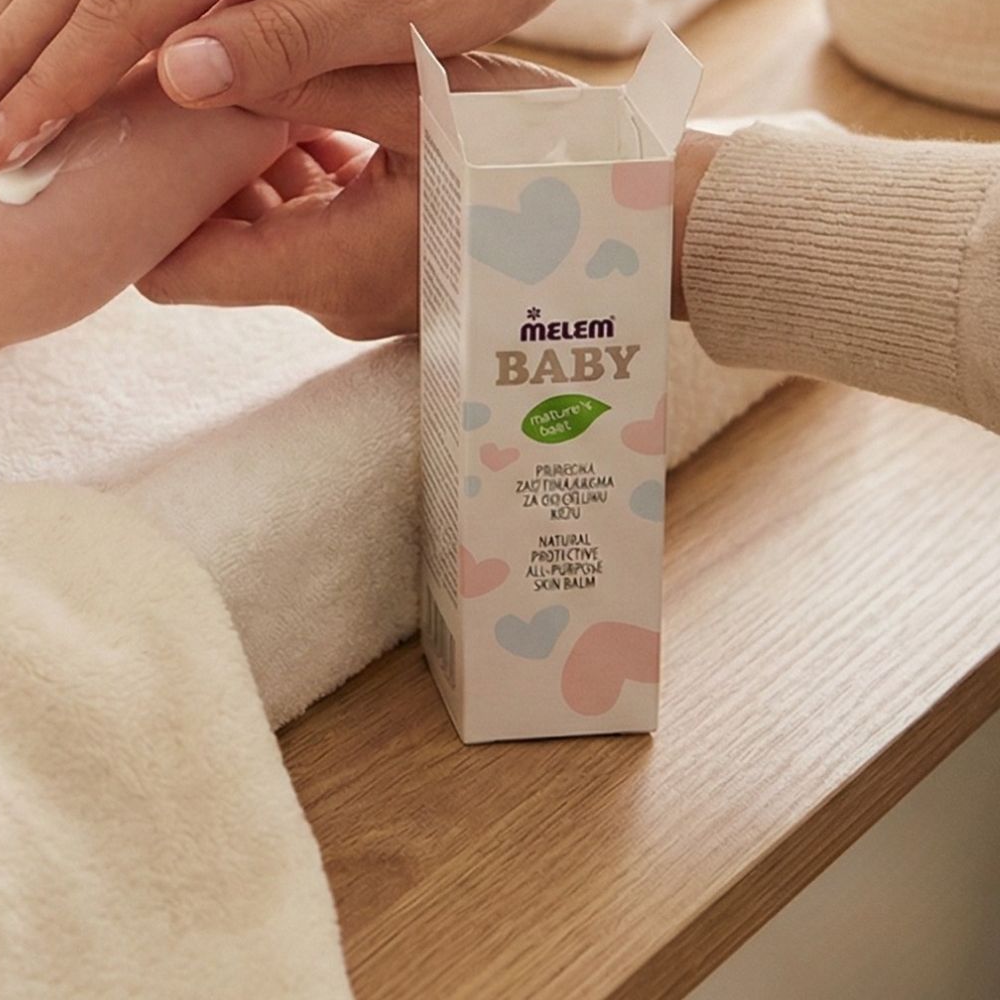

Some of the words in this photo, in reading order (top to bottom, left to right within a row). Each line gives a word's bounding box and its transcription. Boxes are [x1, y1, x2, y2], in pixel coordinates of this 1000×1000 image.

[520, 318, 615, 342] MELEM
[495, 344, 641, 386] BABY
[539, 533, 591, 548] NATURAL
[563, 576, 596, 590] BALM
